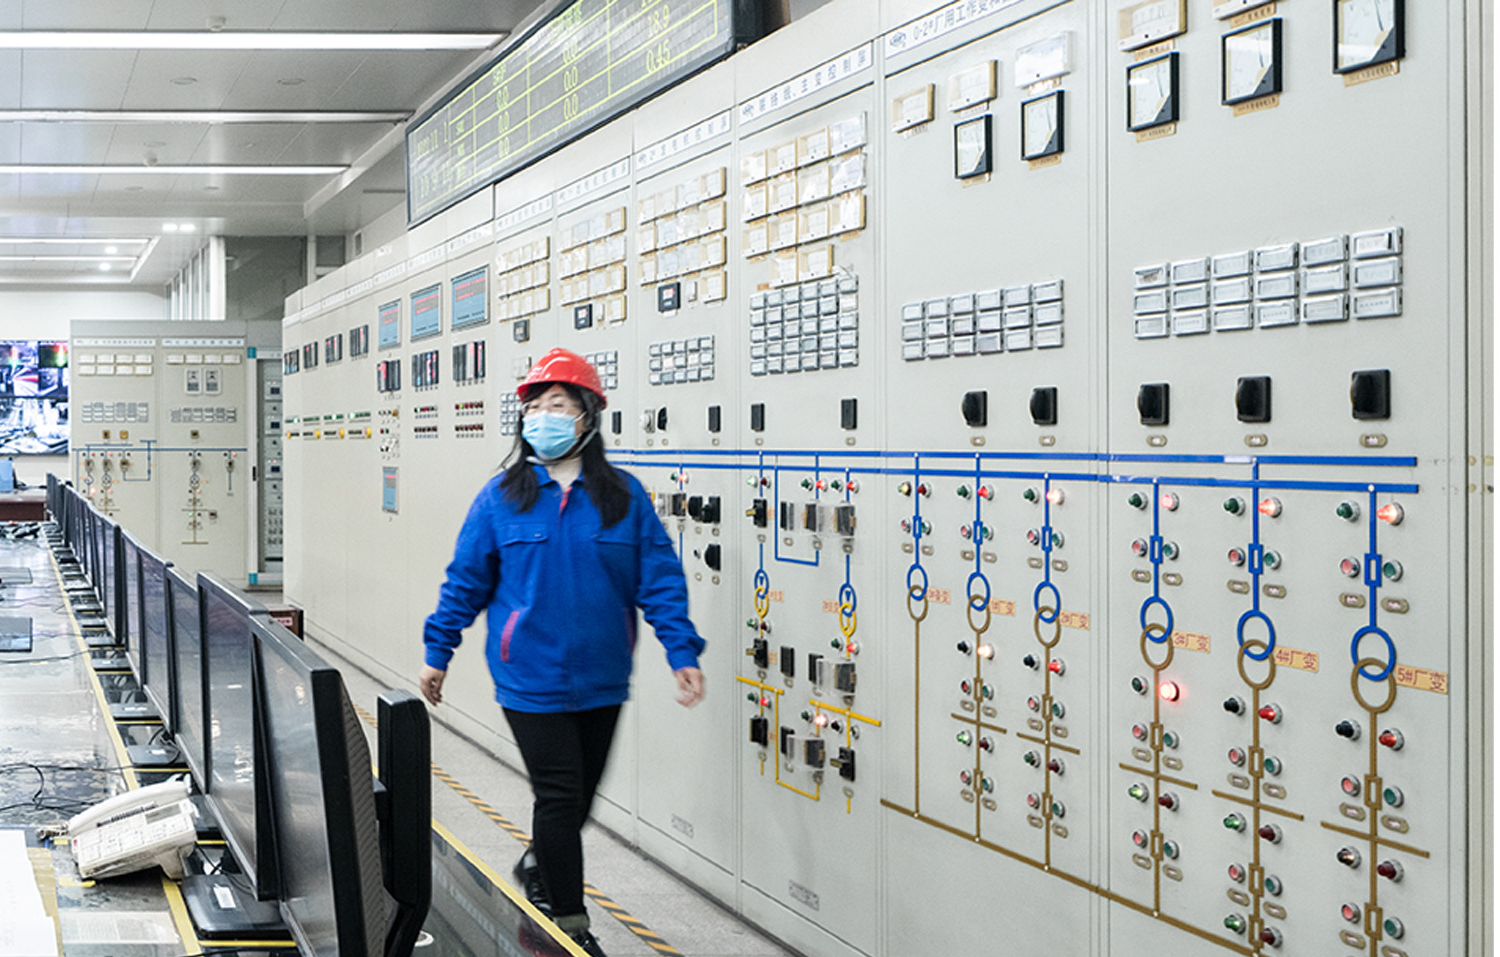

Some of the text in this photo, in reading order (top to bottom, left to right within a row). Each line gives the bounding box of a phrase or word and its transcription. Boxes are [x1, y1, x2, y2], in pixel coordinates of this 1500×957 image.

[646, 39, 670, 73] 0.45
[1276, 649, 1317, 671] 4#厂变
[1397, 667, 1446, 692] 5#厂变
